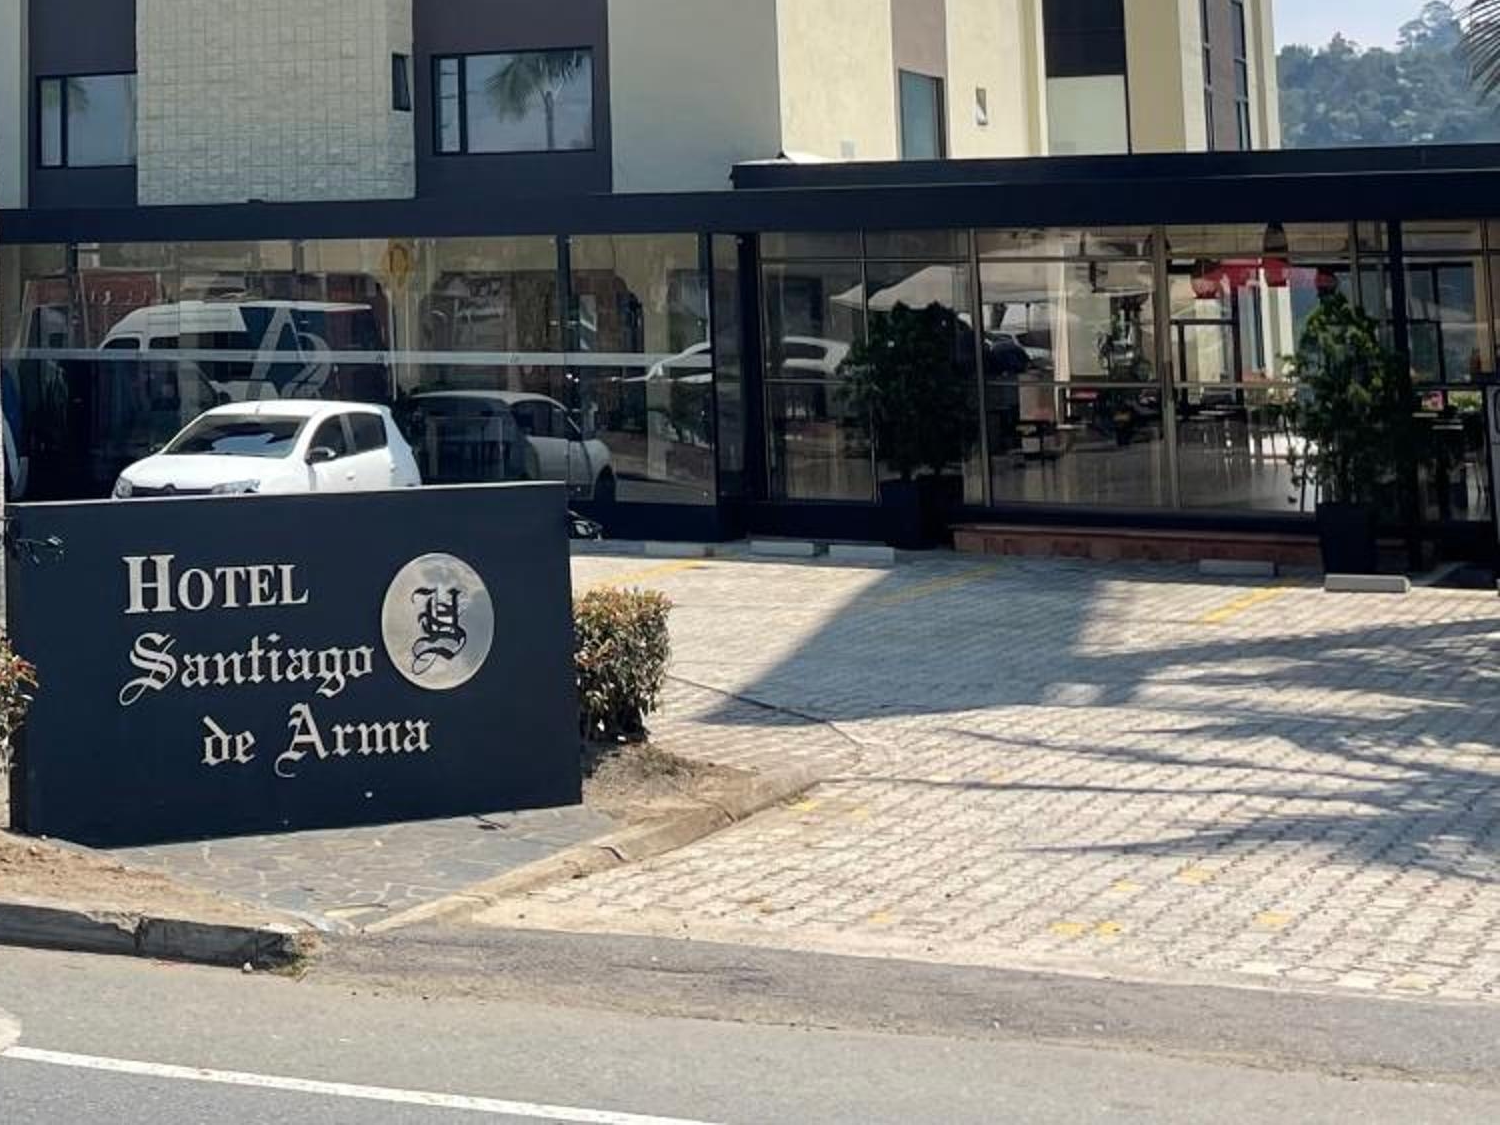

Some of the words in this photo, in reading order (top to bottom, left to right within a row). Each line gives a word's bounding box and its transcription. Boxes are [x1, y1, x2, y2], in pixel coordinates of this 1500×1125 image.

[122, 554, 309, 614] HOTEL
[118, 632, 375, 707] Santiago
[201, 716, 256, 767] de
[275, 702, 432, 778] Arma
